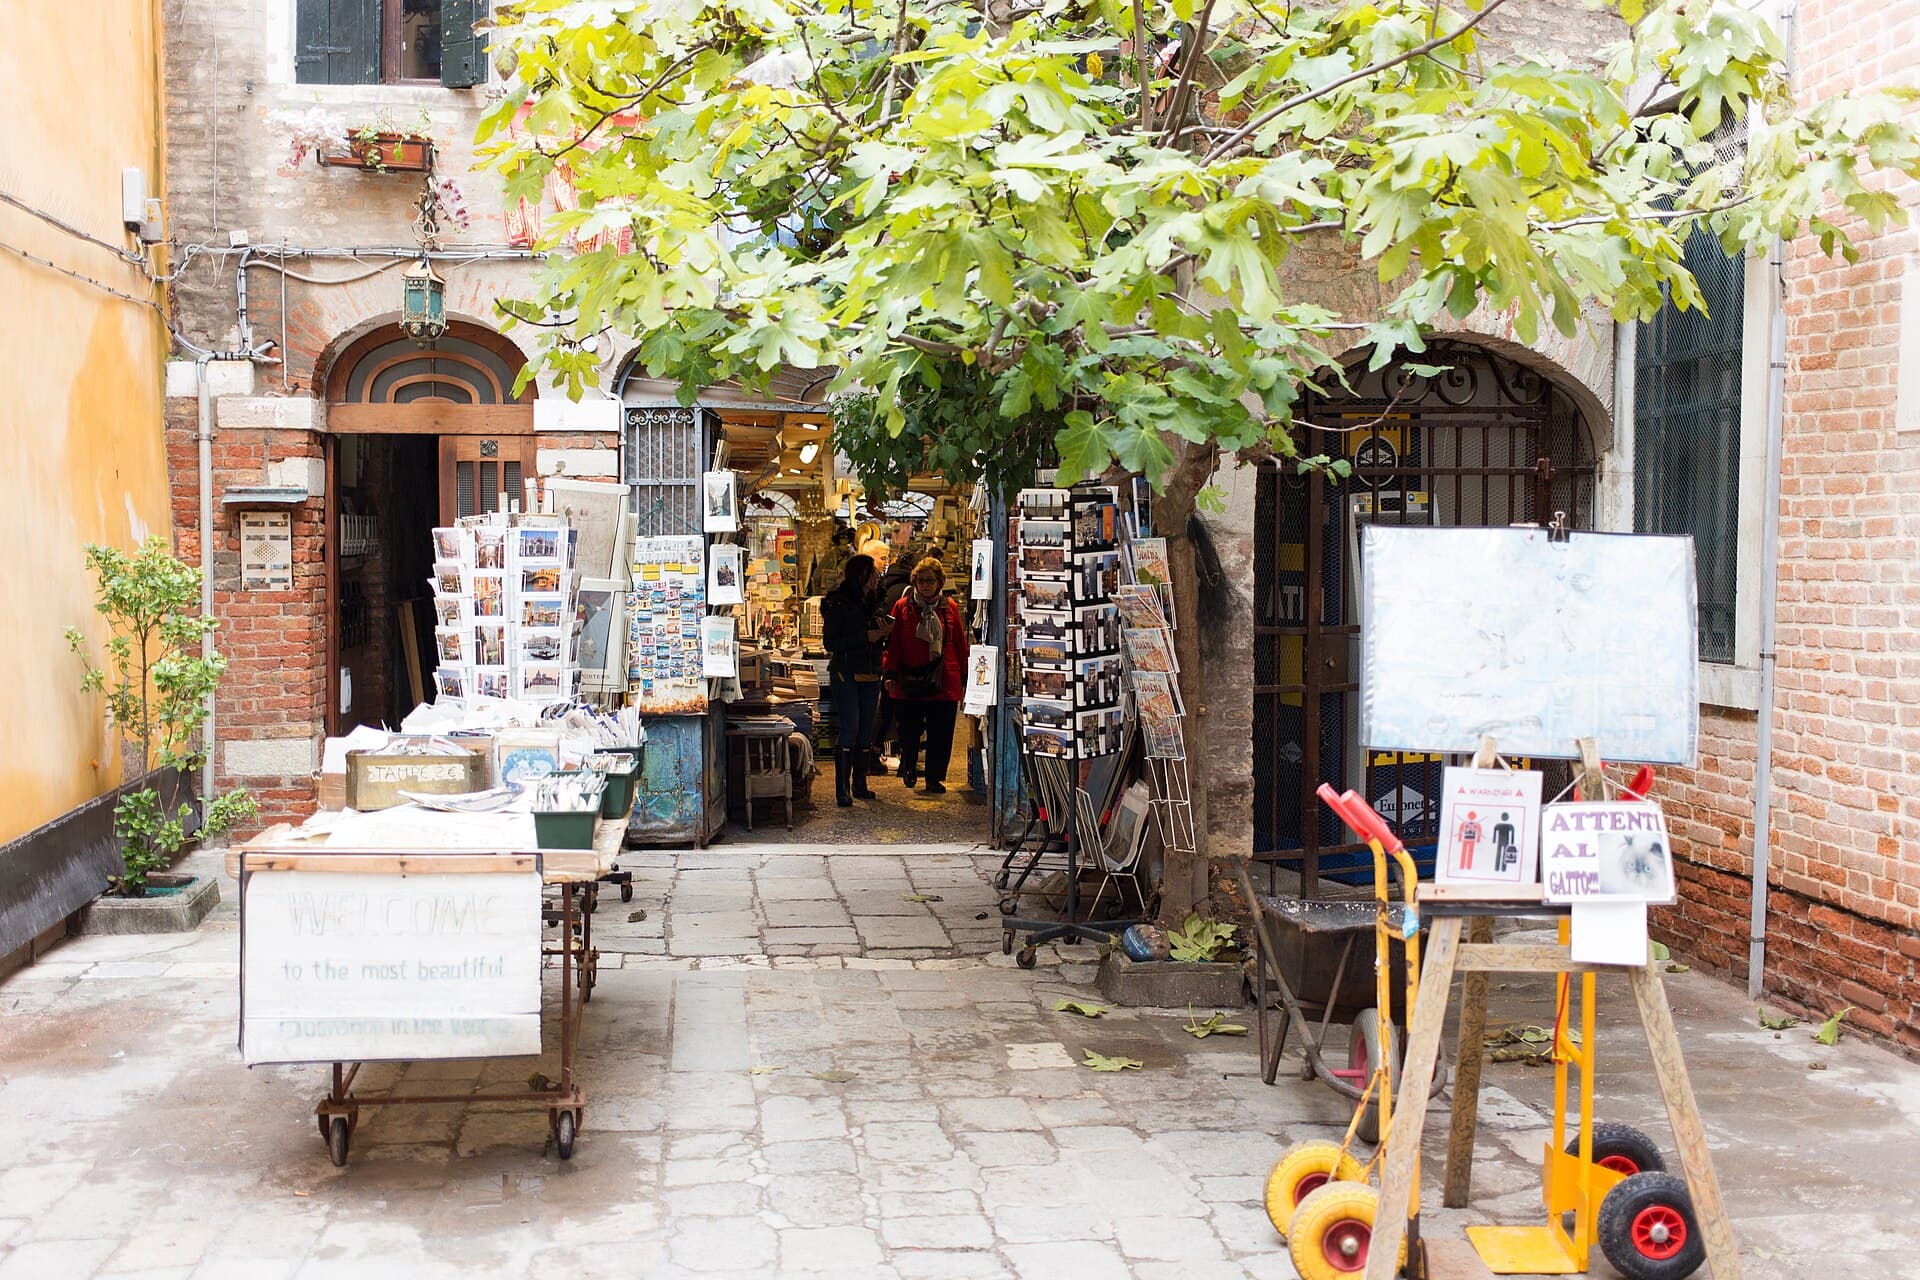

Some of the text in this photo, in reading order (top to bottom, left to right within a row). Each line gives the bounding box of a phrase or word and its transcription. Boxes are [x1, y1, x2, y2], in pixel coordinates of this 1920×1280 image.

[1266, 585, 1325, 622] AT
[1380, 799, 1425, 812] Euonet
[1550, 811, 1662, 832] ATTENTI
[1551, 843, 1596, 858] AL
[287, 889, 506, 937] WELCOME
[281, 953, 505, 981] to the most beautiful
